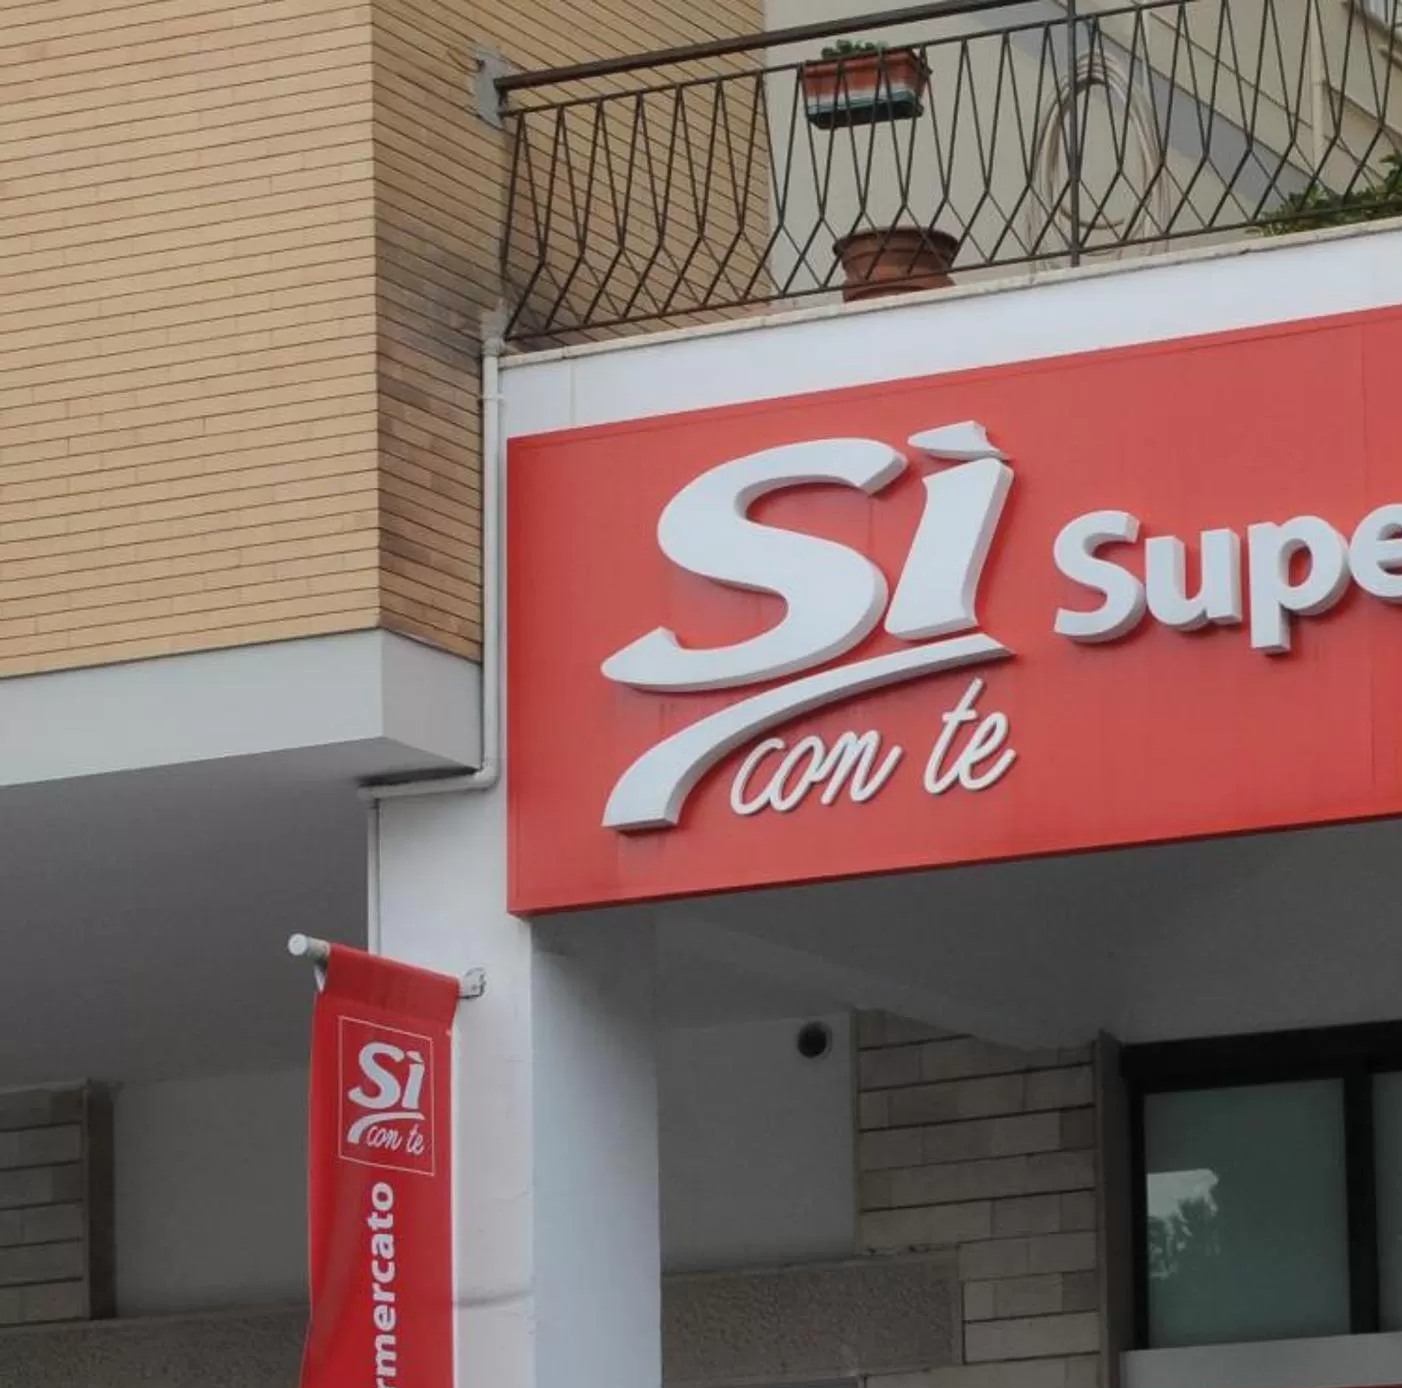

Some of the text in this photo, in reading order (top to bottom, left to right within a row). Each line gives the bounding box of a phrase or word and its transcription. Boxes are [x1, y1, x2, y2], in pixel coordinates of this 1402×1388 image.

[730, 677, 1017, 816] con te
[366, 1123, 425, 1156] con te
